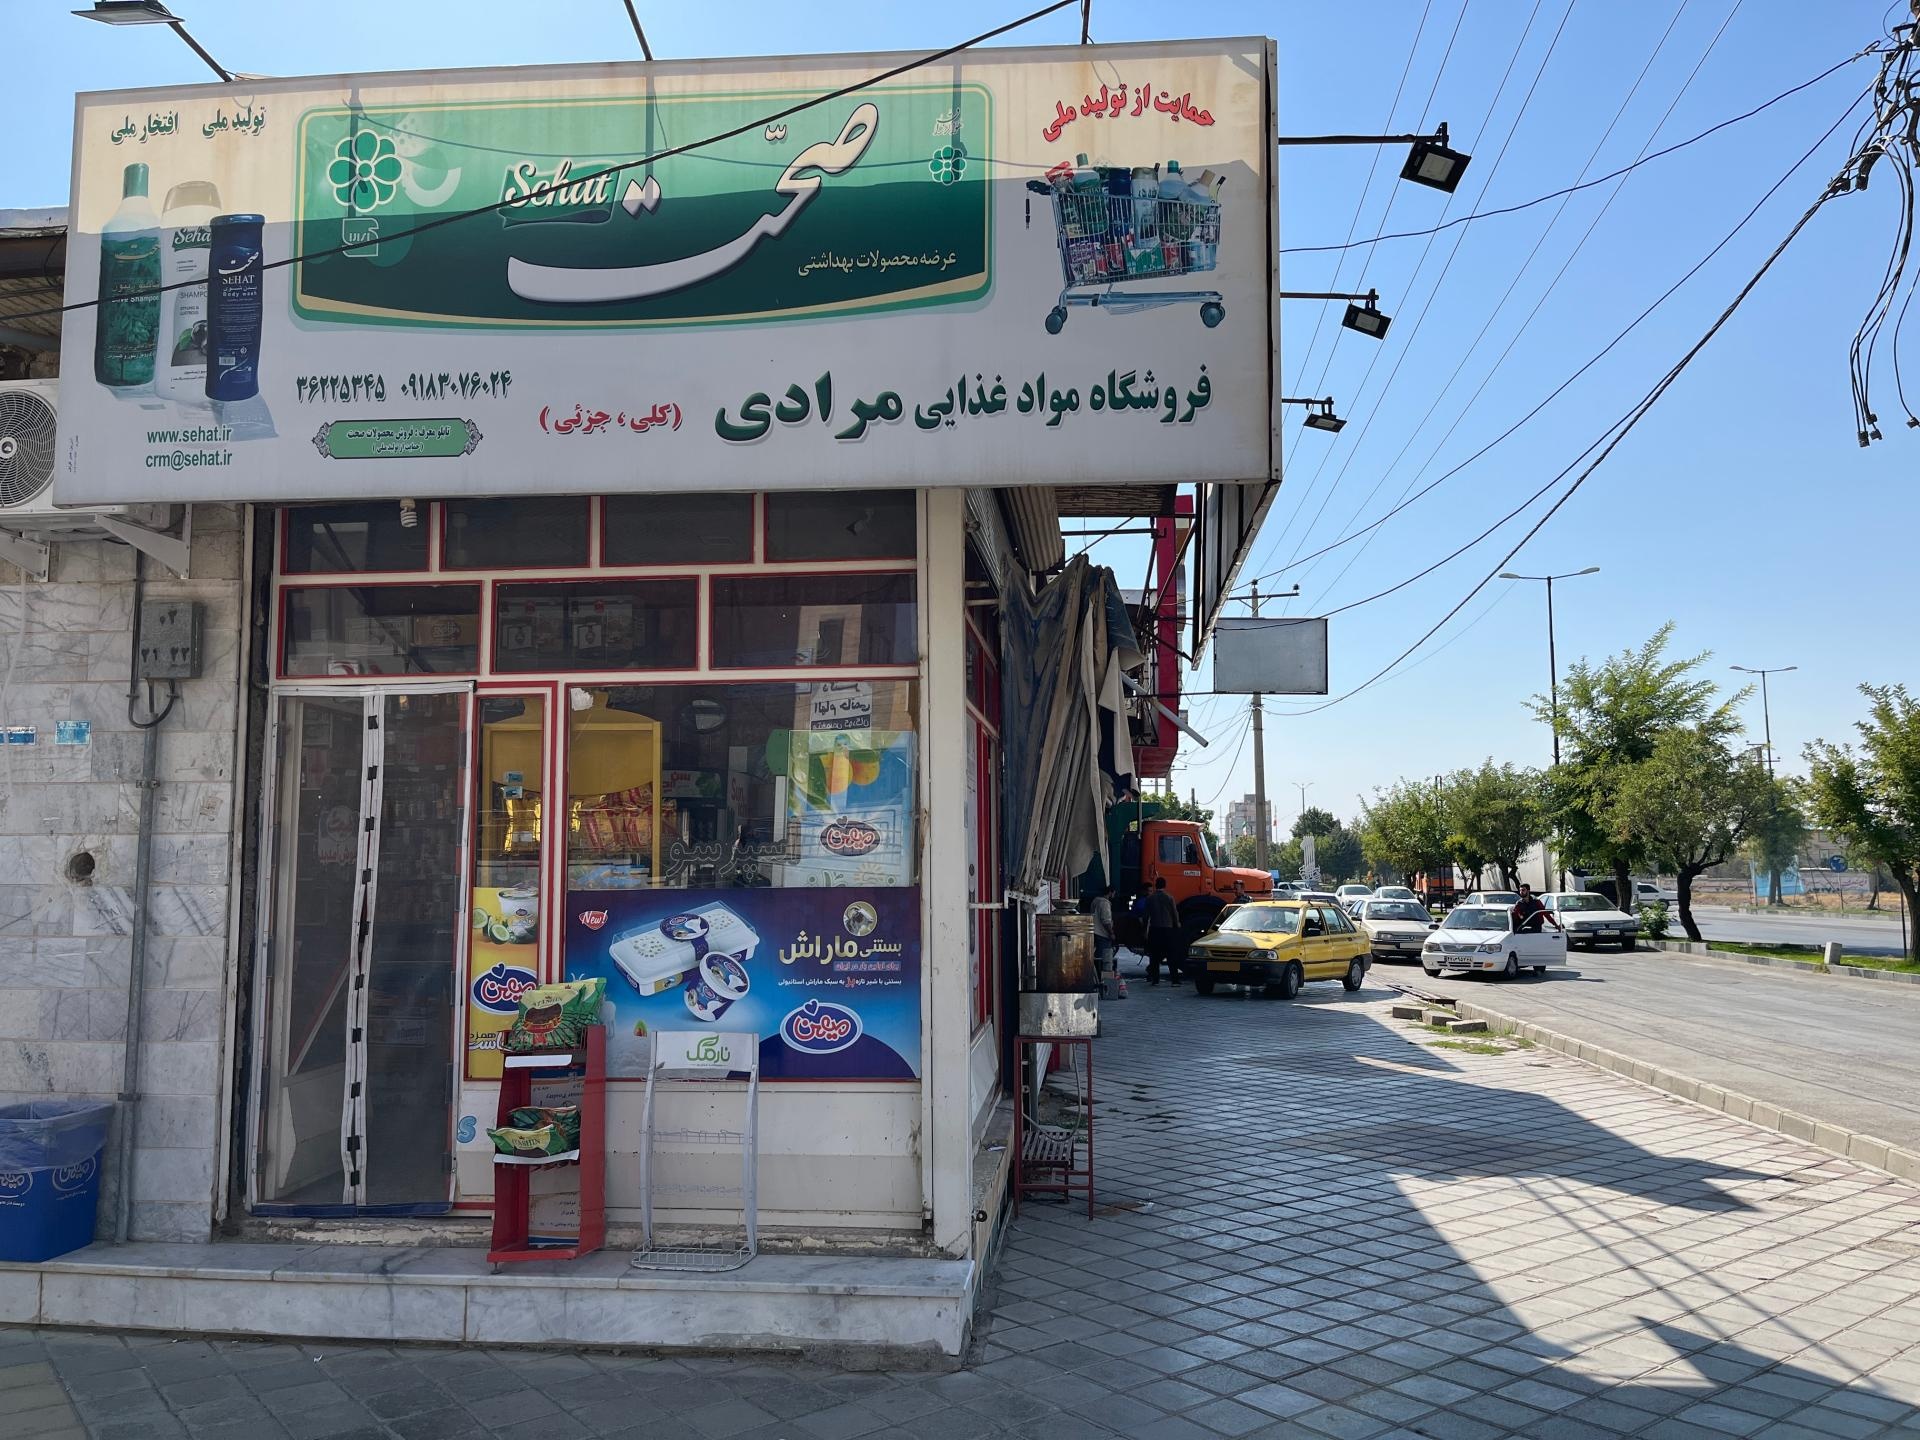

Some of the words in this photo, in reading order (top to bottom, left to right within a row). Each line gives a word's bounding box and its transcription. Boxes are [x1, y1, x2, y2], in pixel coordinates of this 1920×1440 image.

[1081, 84, 1127, 118] تولید
[1131, 83, 1150, 116] از
[1153, 91, 1215, 126] حمایت
[111, 116, 136, 143] ملی
[140, 111, 179, 141] افتخار
[202, 109, 229, 137] ملی
[232, 105, 266, 136] تولید
[1043, 100, 1077, 142] ملی
[505, 159, 614, 208] Sehat
[174, 228, 212, 245] Seha
[798, 251, 853, 276] بهداشتی
[856, 250, 918, 273] محصولات
[920, 250, 957, 271] عرضه
[222, 275, 255, 284] SEHAT
[180, 290, 208, 298] SHAMPO
[296, 374, 386, 402] ۳۶۲۲۵۳۴۵
[400, 370, 513, 401] ۰۹۱۸۳۰۷۶۰۲۴
[1089, 364, 1212, 426] فروشگاه
[713, 370, 904, 443] مرادی
[914, 372, 1007, 430] غذایی
[1015, 371, 1080, 428] مواد
[147, 425, 232, 443] www.sehat.ir
[366, 427, 394, 441] محصولات
[395, 428, 414, 441] فروش
[437, 425, 451, 438] تابلو
[145, 449, 233, 471] crm@sehat.ir
[581, 910, 608, 925] New!
[779, 930, 858, 965] ماراش
[859, 939, 901, 957] بستنی
[793, 1015, 851, 1041] میهن
